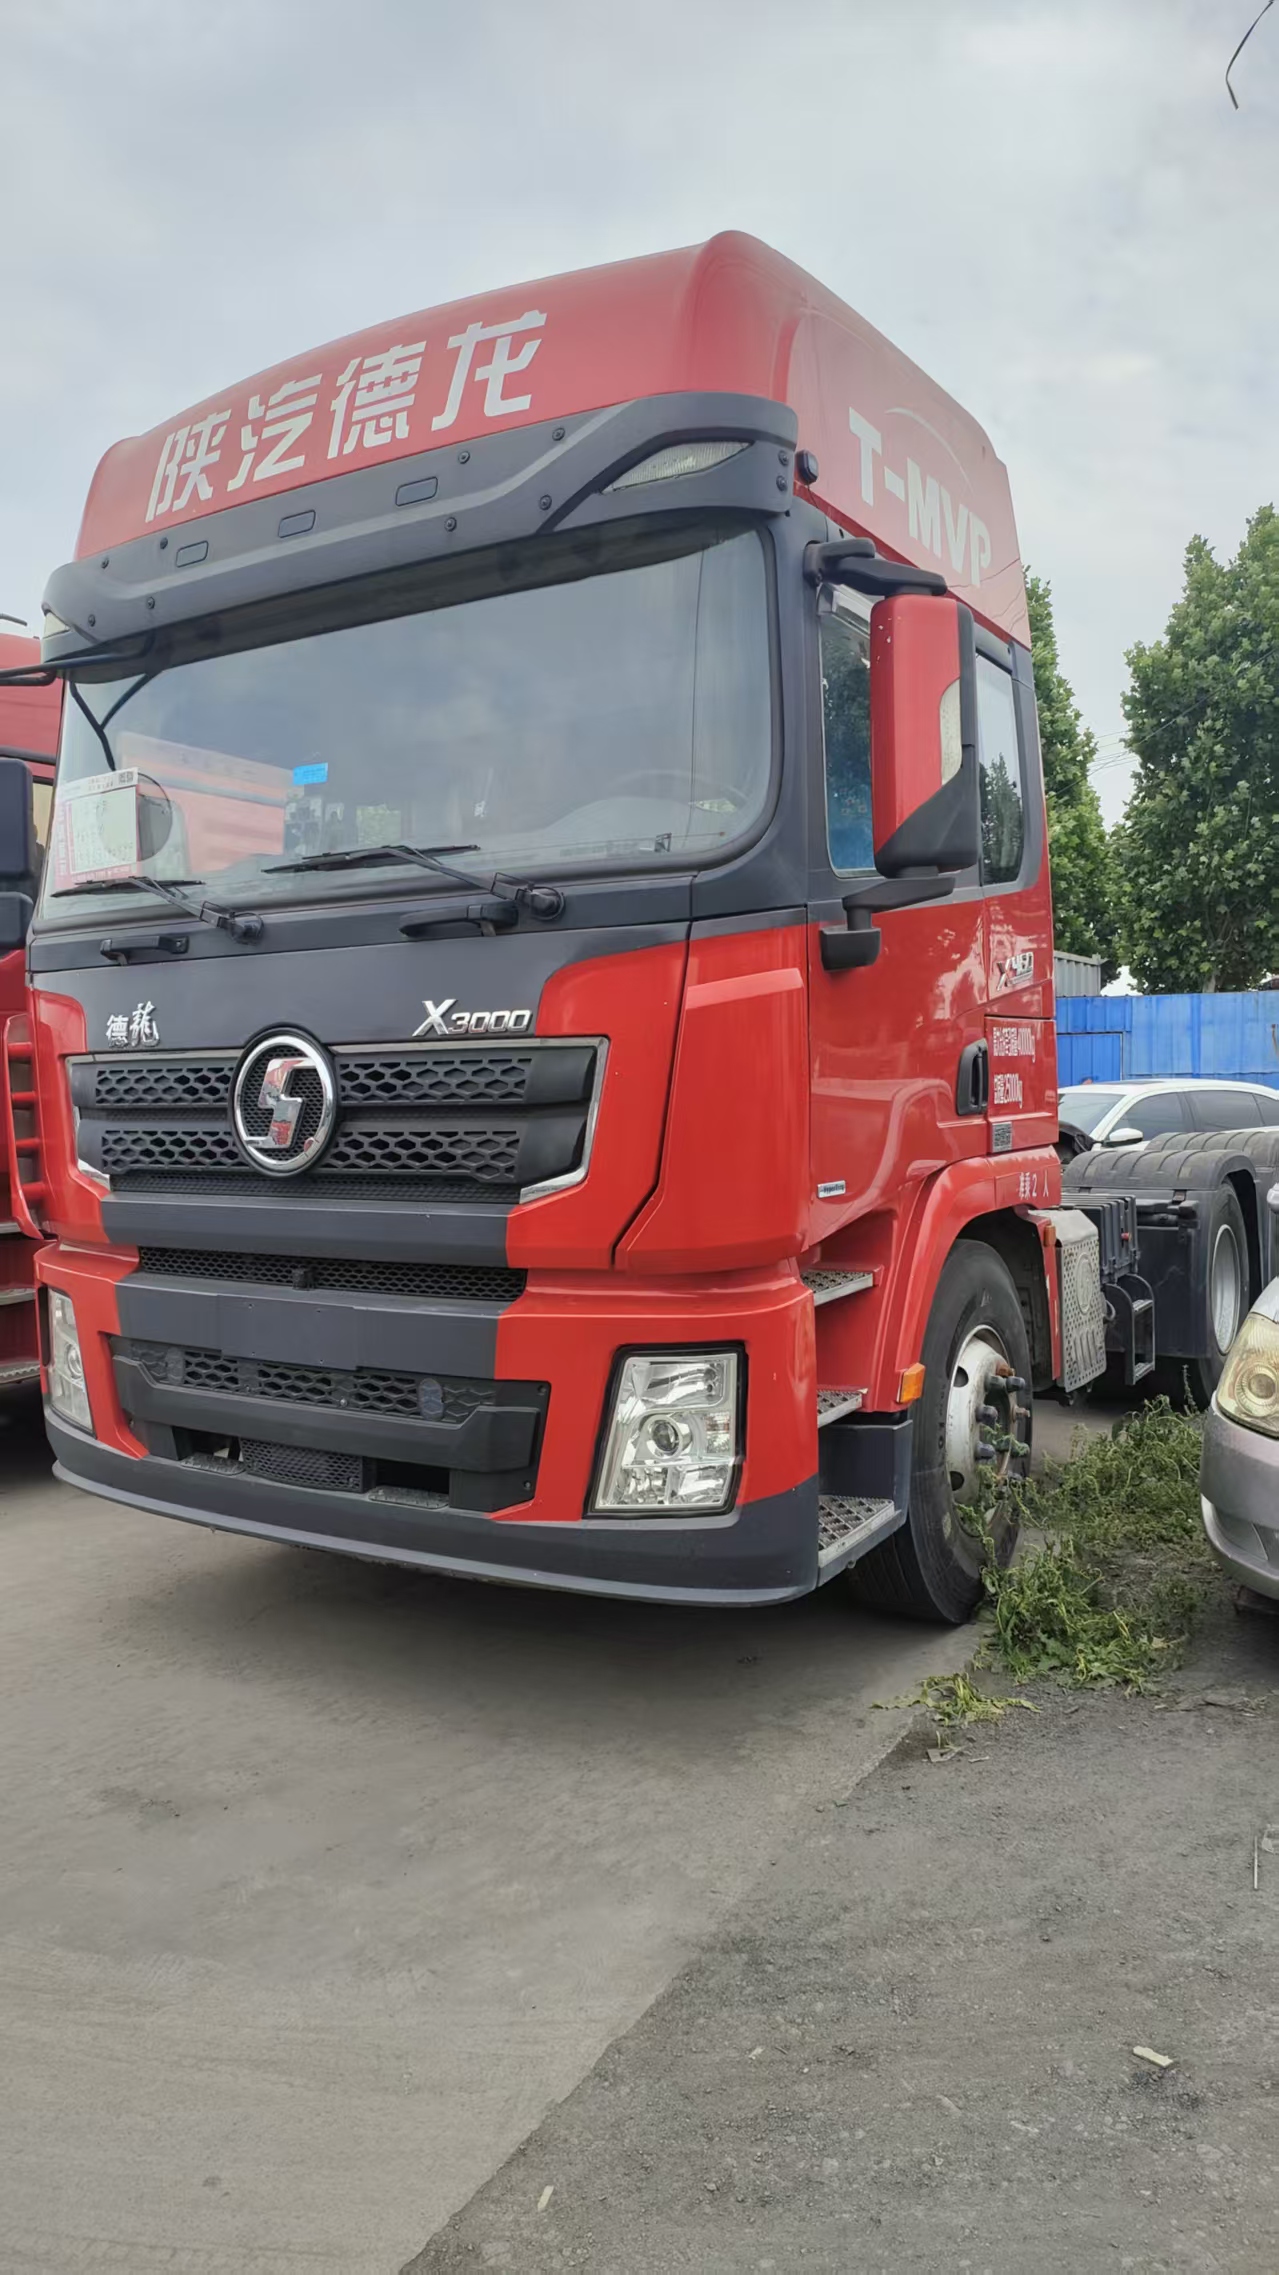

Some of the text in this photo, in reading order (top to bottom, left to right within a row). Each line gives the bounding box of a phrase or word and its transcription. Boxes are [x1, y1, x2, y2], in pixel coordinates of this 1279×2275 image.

[145, 310, 547, 523] 陕汽德龙
[849, 407, 992, 588] T-MVP
[412, 999, 532, 1036] X3000
